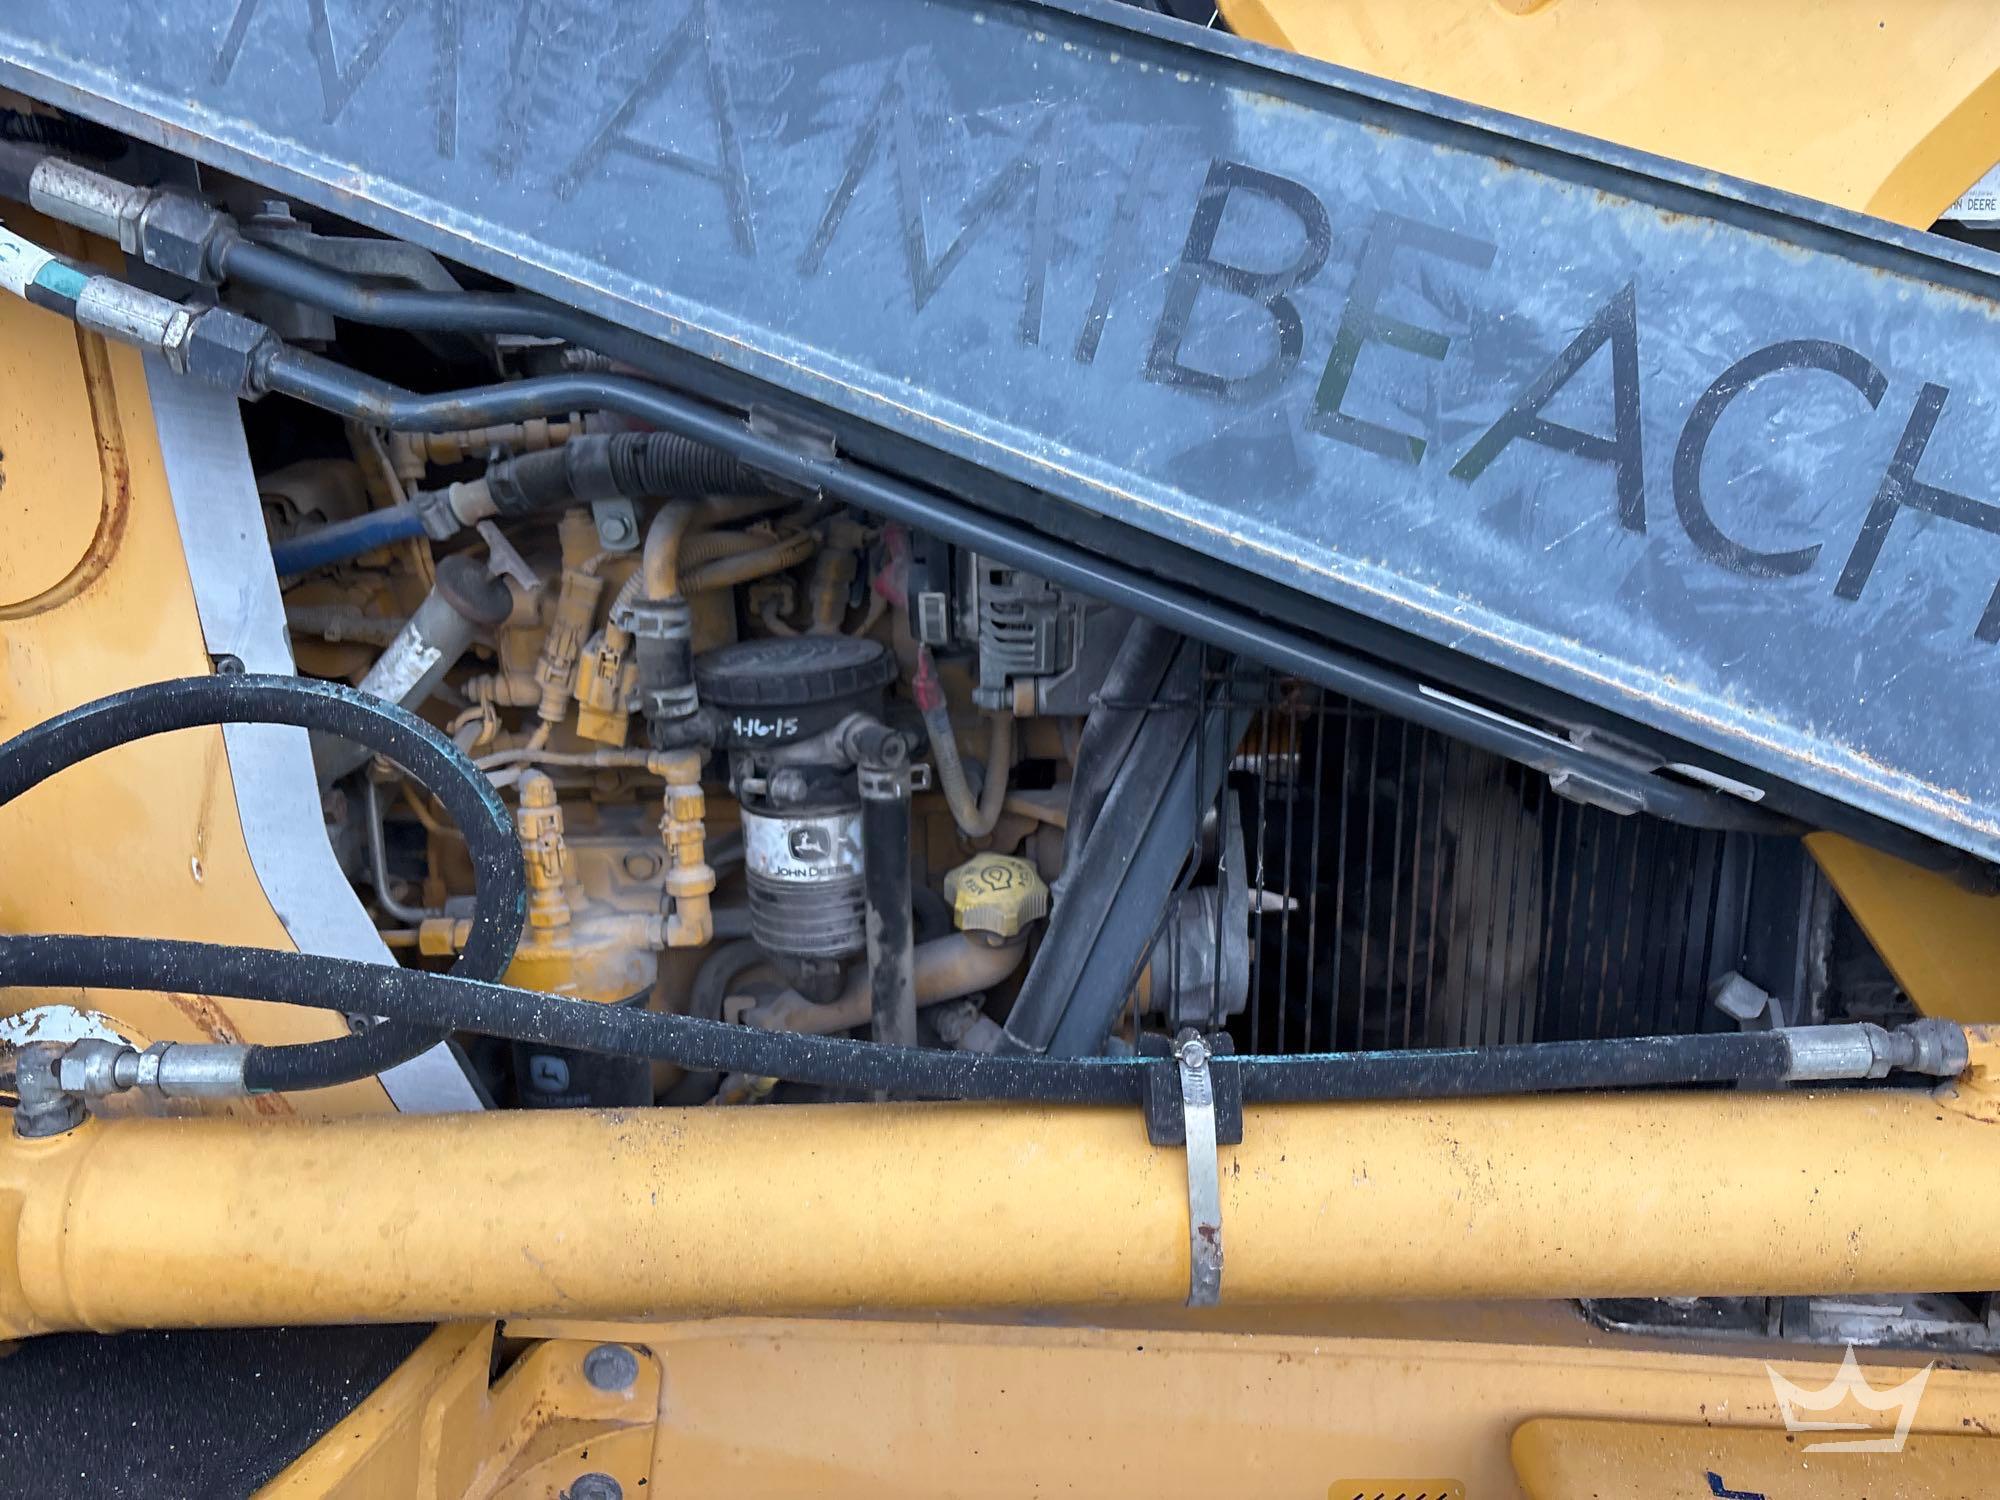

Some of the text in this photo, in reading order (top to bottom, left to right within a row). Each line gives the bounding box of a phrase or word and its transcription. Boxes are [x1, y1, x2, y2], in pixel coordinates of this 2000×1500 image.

[1967, 198, 1997, 211] DEERE
[1142, 158, 2000, 643] BEACH
[775, 866, 807, 877] JOHN
